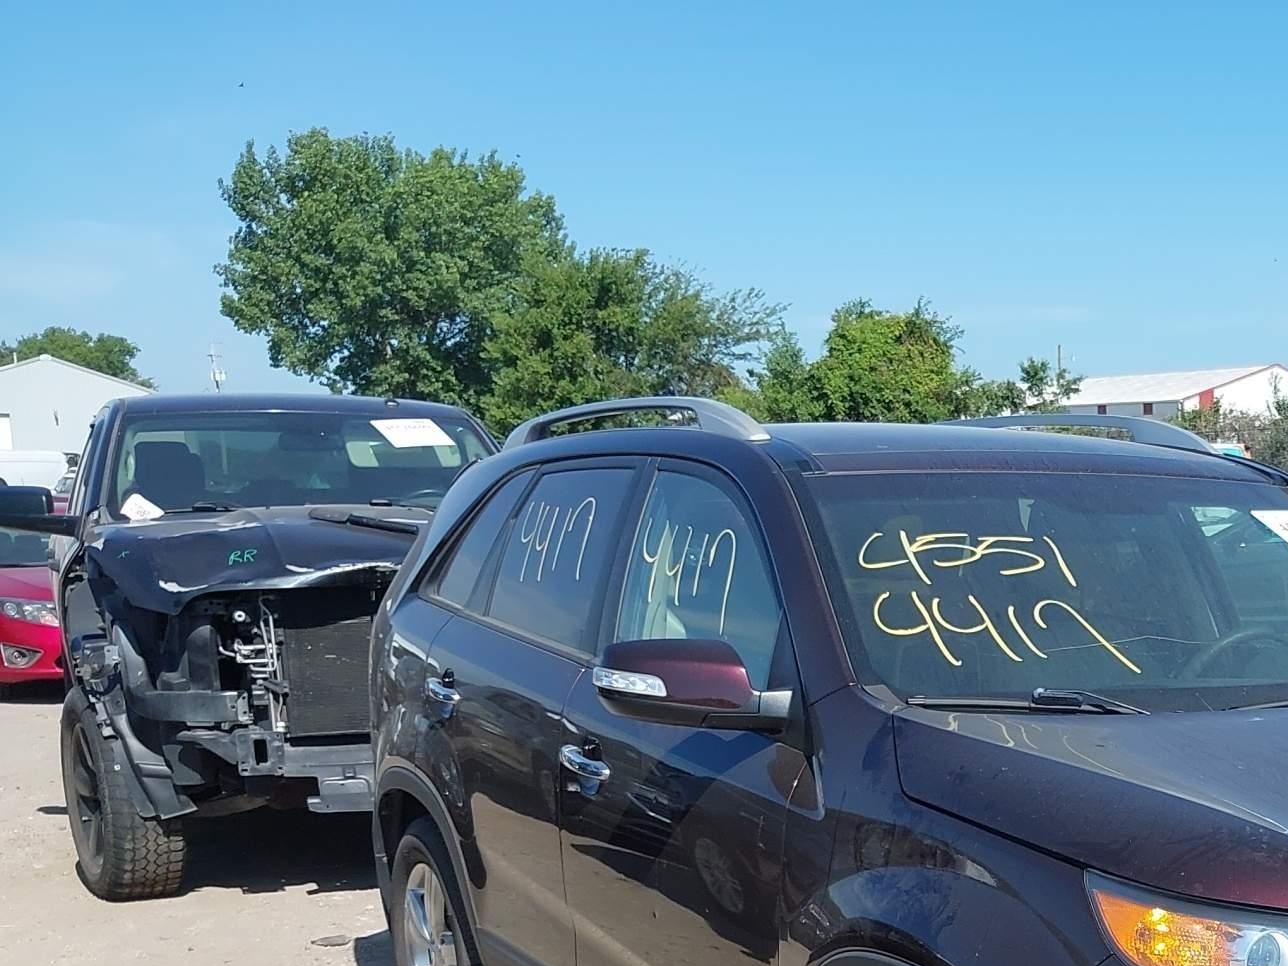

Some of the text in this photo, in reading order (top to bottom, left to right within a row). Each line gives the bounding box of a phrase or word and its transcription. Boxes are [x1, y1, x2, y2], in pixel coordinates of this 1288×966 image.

[228, 549, 257, 565] RR
[858, 530, 1077, 587] 4551
[873, 590, 1142, 674] 4417
